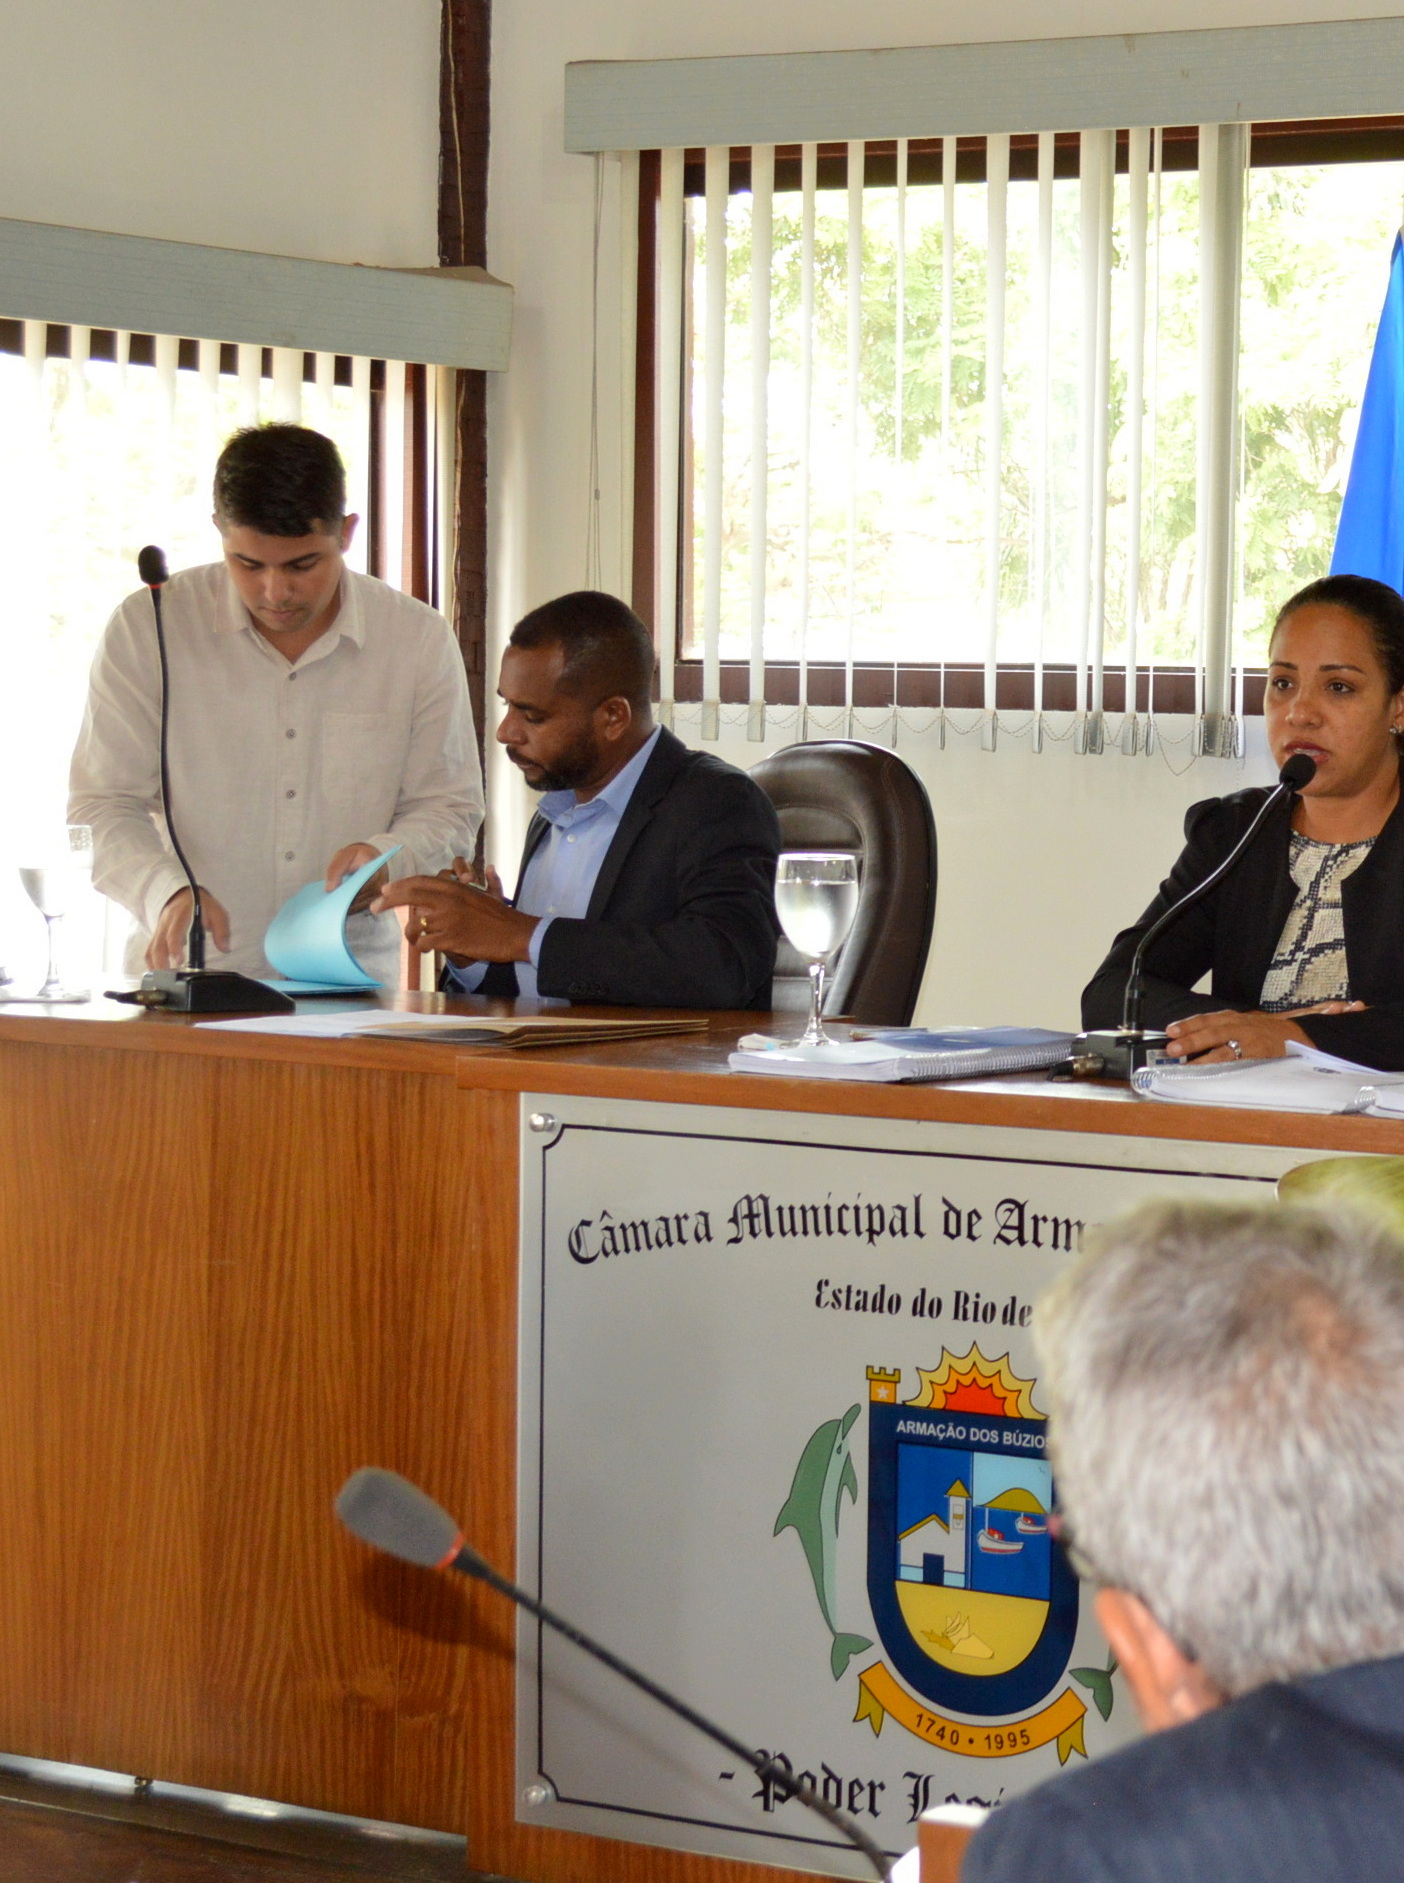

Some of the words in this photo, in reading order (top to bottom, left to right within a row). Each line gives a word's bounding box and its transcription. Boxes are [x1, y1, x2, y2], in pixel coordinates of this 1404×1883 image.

[567, 1209, 714, 1265] Câmara
[727, 1192, 927, 1247] Municipal
[941, 1196, 983, 1242] de
[993, 1198, 1105, 1253] Arm
[816, 1279, 901, 1316] Estado
[911, 1287, 943, 1319] do
[952, 1290, 997, 1324] Rio
[1001, 1295, 1033, 1328] de
[896, 1419, 967, 1442] ARMAÇÃO
[969, 1427, 1000, 1444] DOS
[915, 1712, 960, 1746] 1740
[984, 1728, 1031, 1750] 1995
[751, 1748, 886, 1819] Poder
